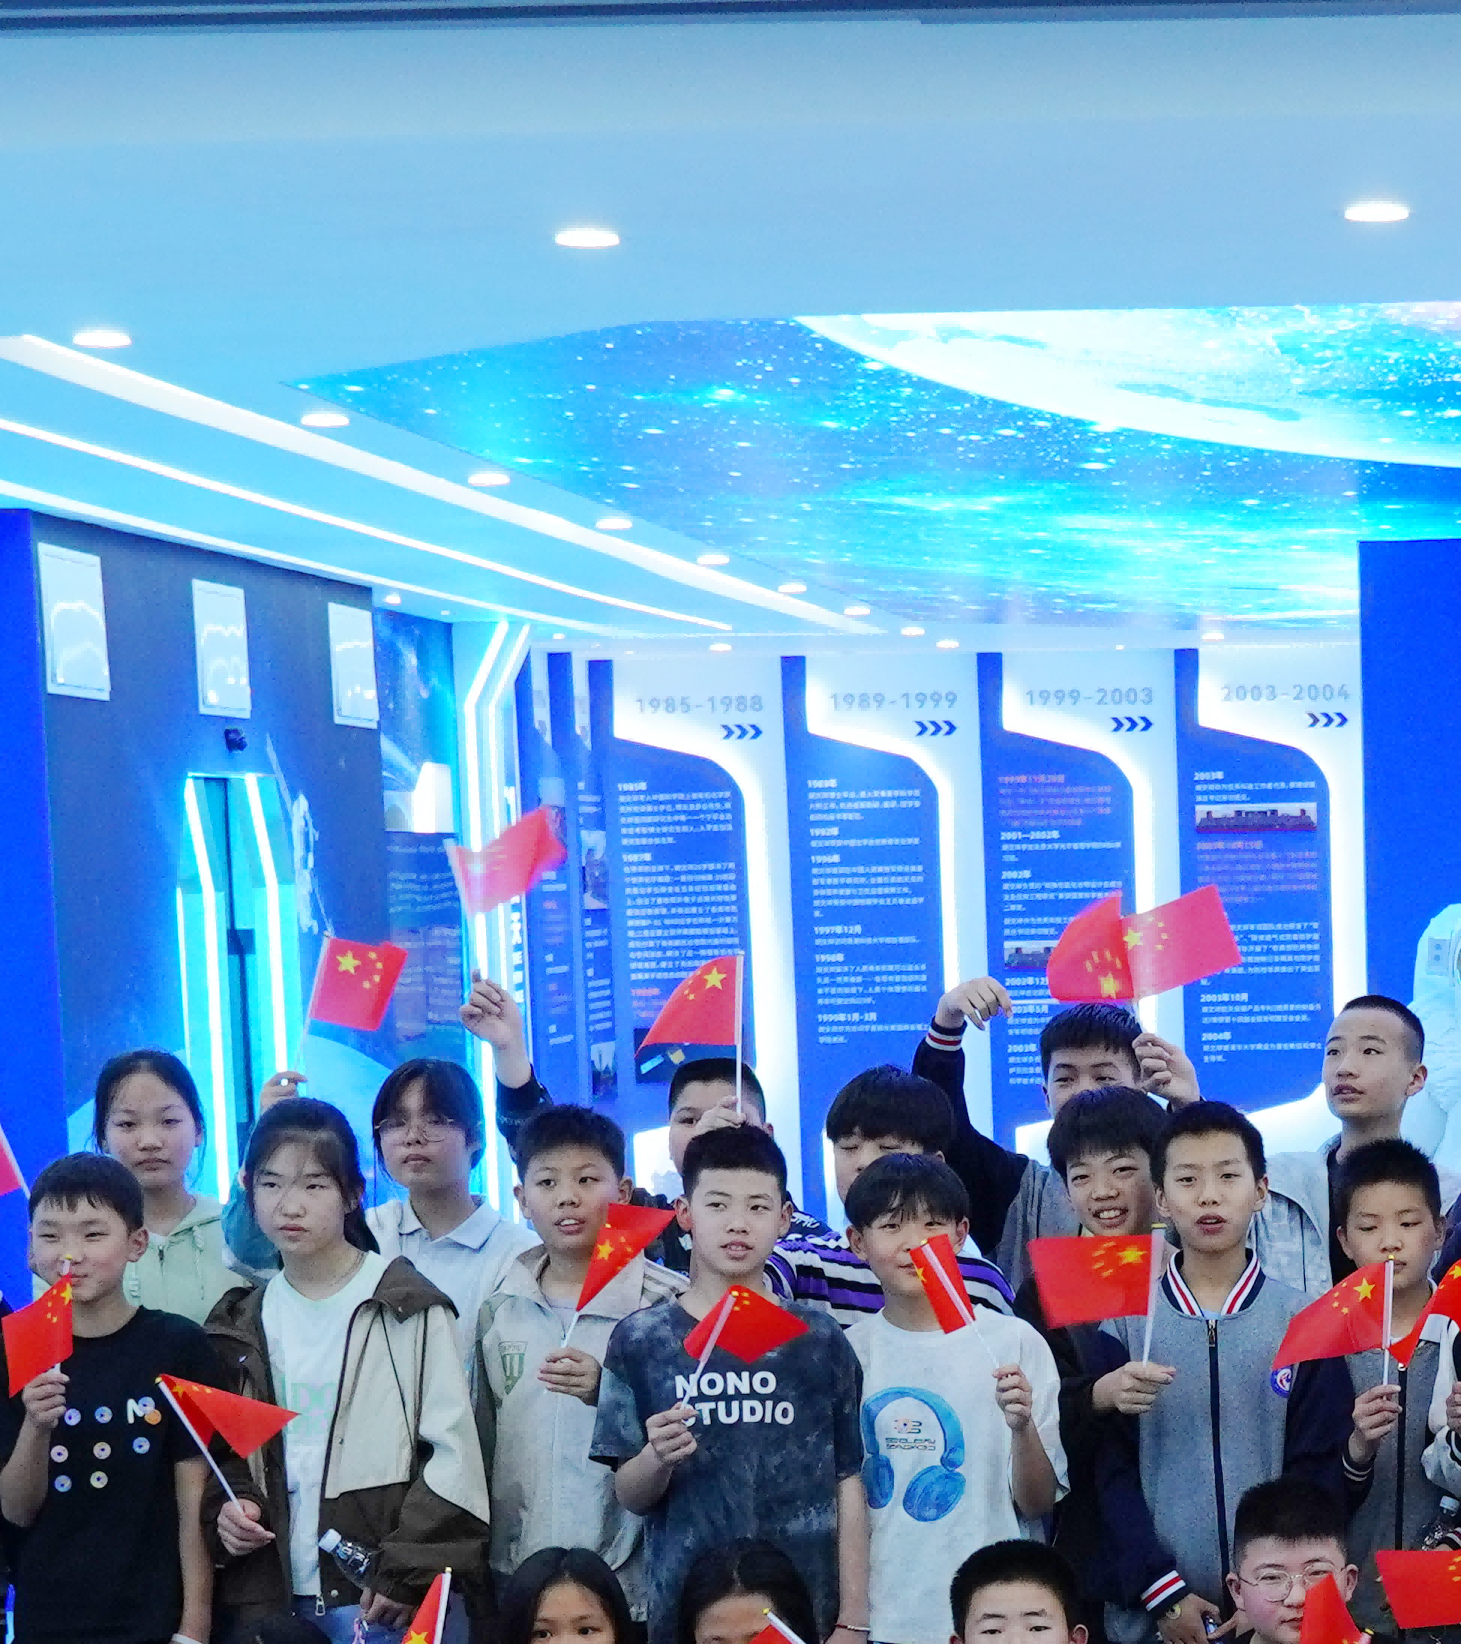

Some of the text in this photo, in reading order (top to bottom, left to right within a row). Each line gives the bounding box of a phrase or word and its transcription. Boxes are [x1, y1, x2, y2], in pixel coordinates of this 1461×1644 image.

[830, 692, 957, 711] 1989-1999
[1026, 687, 1153, 706] 1999-2003
[1221, 684, 1350, 702] 2003-2004
[636, 695, 763, 714] 1985-1988
[675, 1371, 777, 1399] NONO
